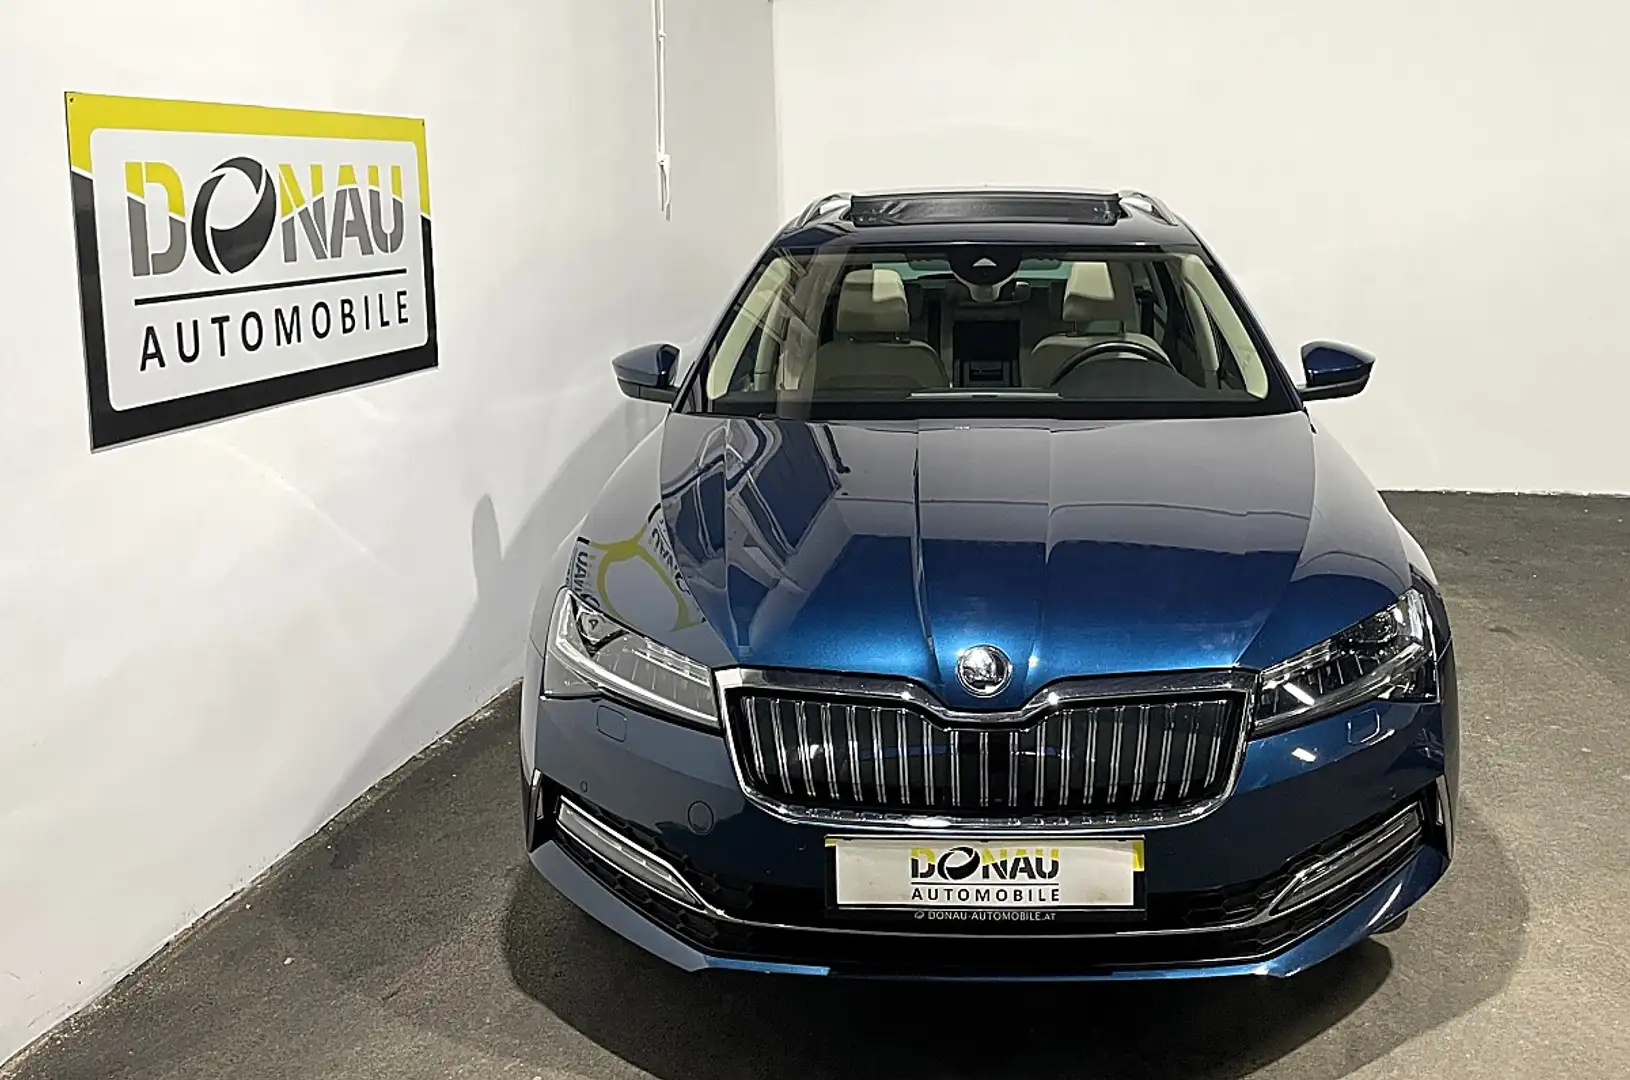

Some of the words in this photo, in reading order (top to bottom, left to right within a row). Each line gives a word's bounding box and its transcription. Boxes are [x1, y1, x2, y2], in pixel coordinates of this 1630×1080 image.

[124, 156, 404, 277] DONAU
[139, 290, 409, 372] AUTOMOBILE
[911, 846, 1060, 881] DONAU
[911, 888, 1060, 901] AUTOMOBILE
